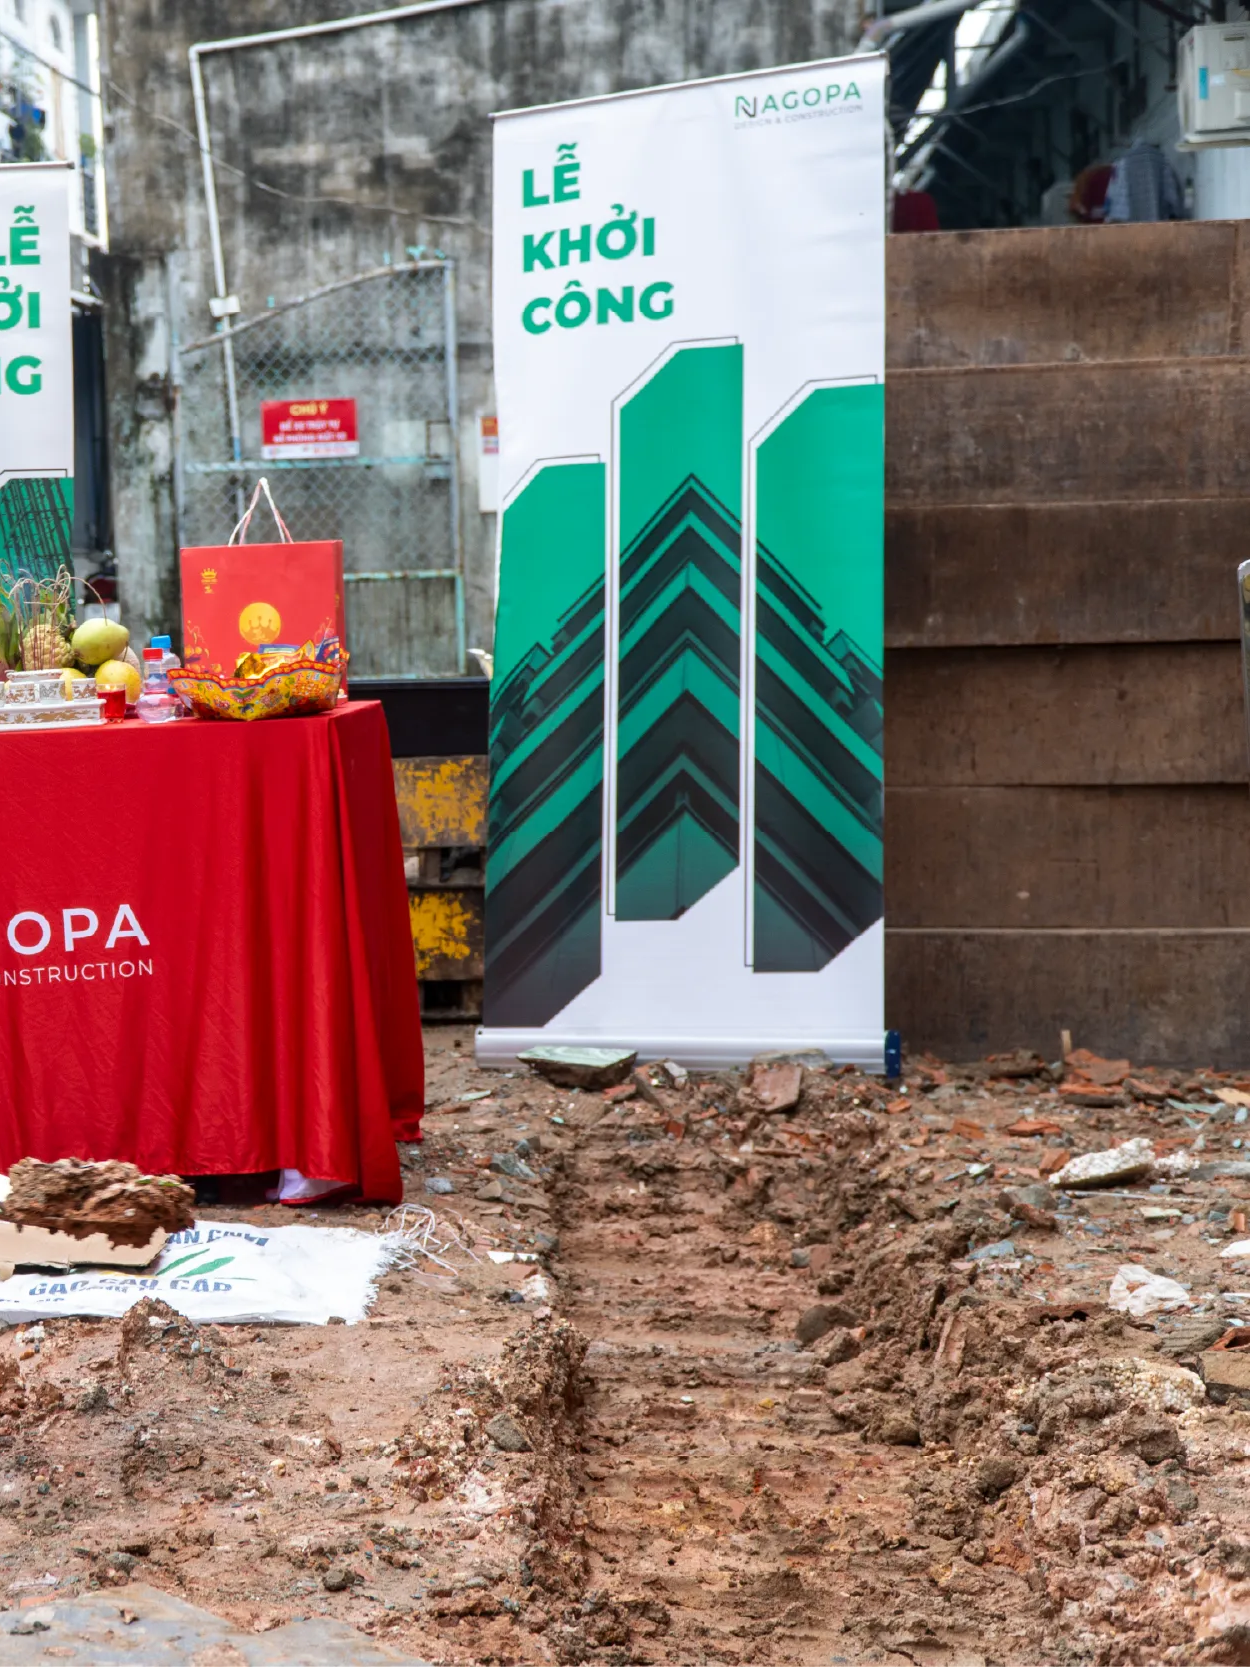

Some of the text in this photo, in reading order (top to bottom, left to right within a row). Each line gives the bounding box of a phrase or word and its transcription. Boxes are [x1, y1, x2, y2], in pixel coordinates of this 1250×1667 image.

[735, 82, 861, 118] NAGOPA
[785, 105, 862, 123] CONSTRUCTION
[523, 143, 580, 208] LỄ
[523, 203, 655, 273] KHỞI
[521, 280, 674, 335] CÔNG
